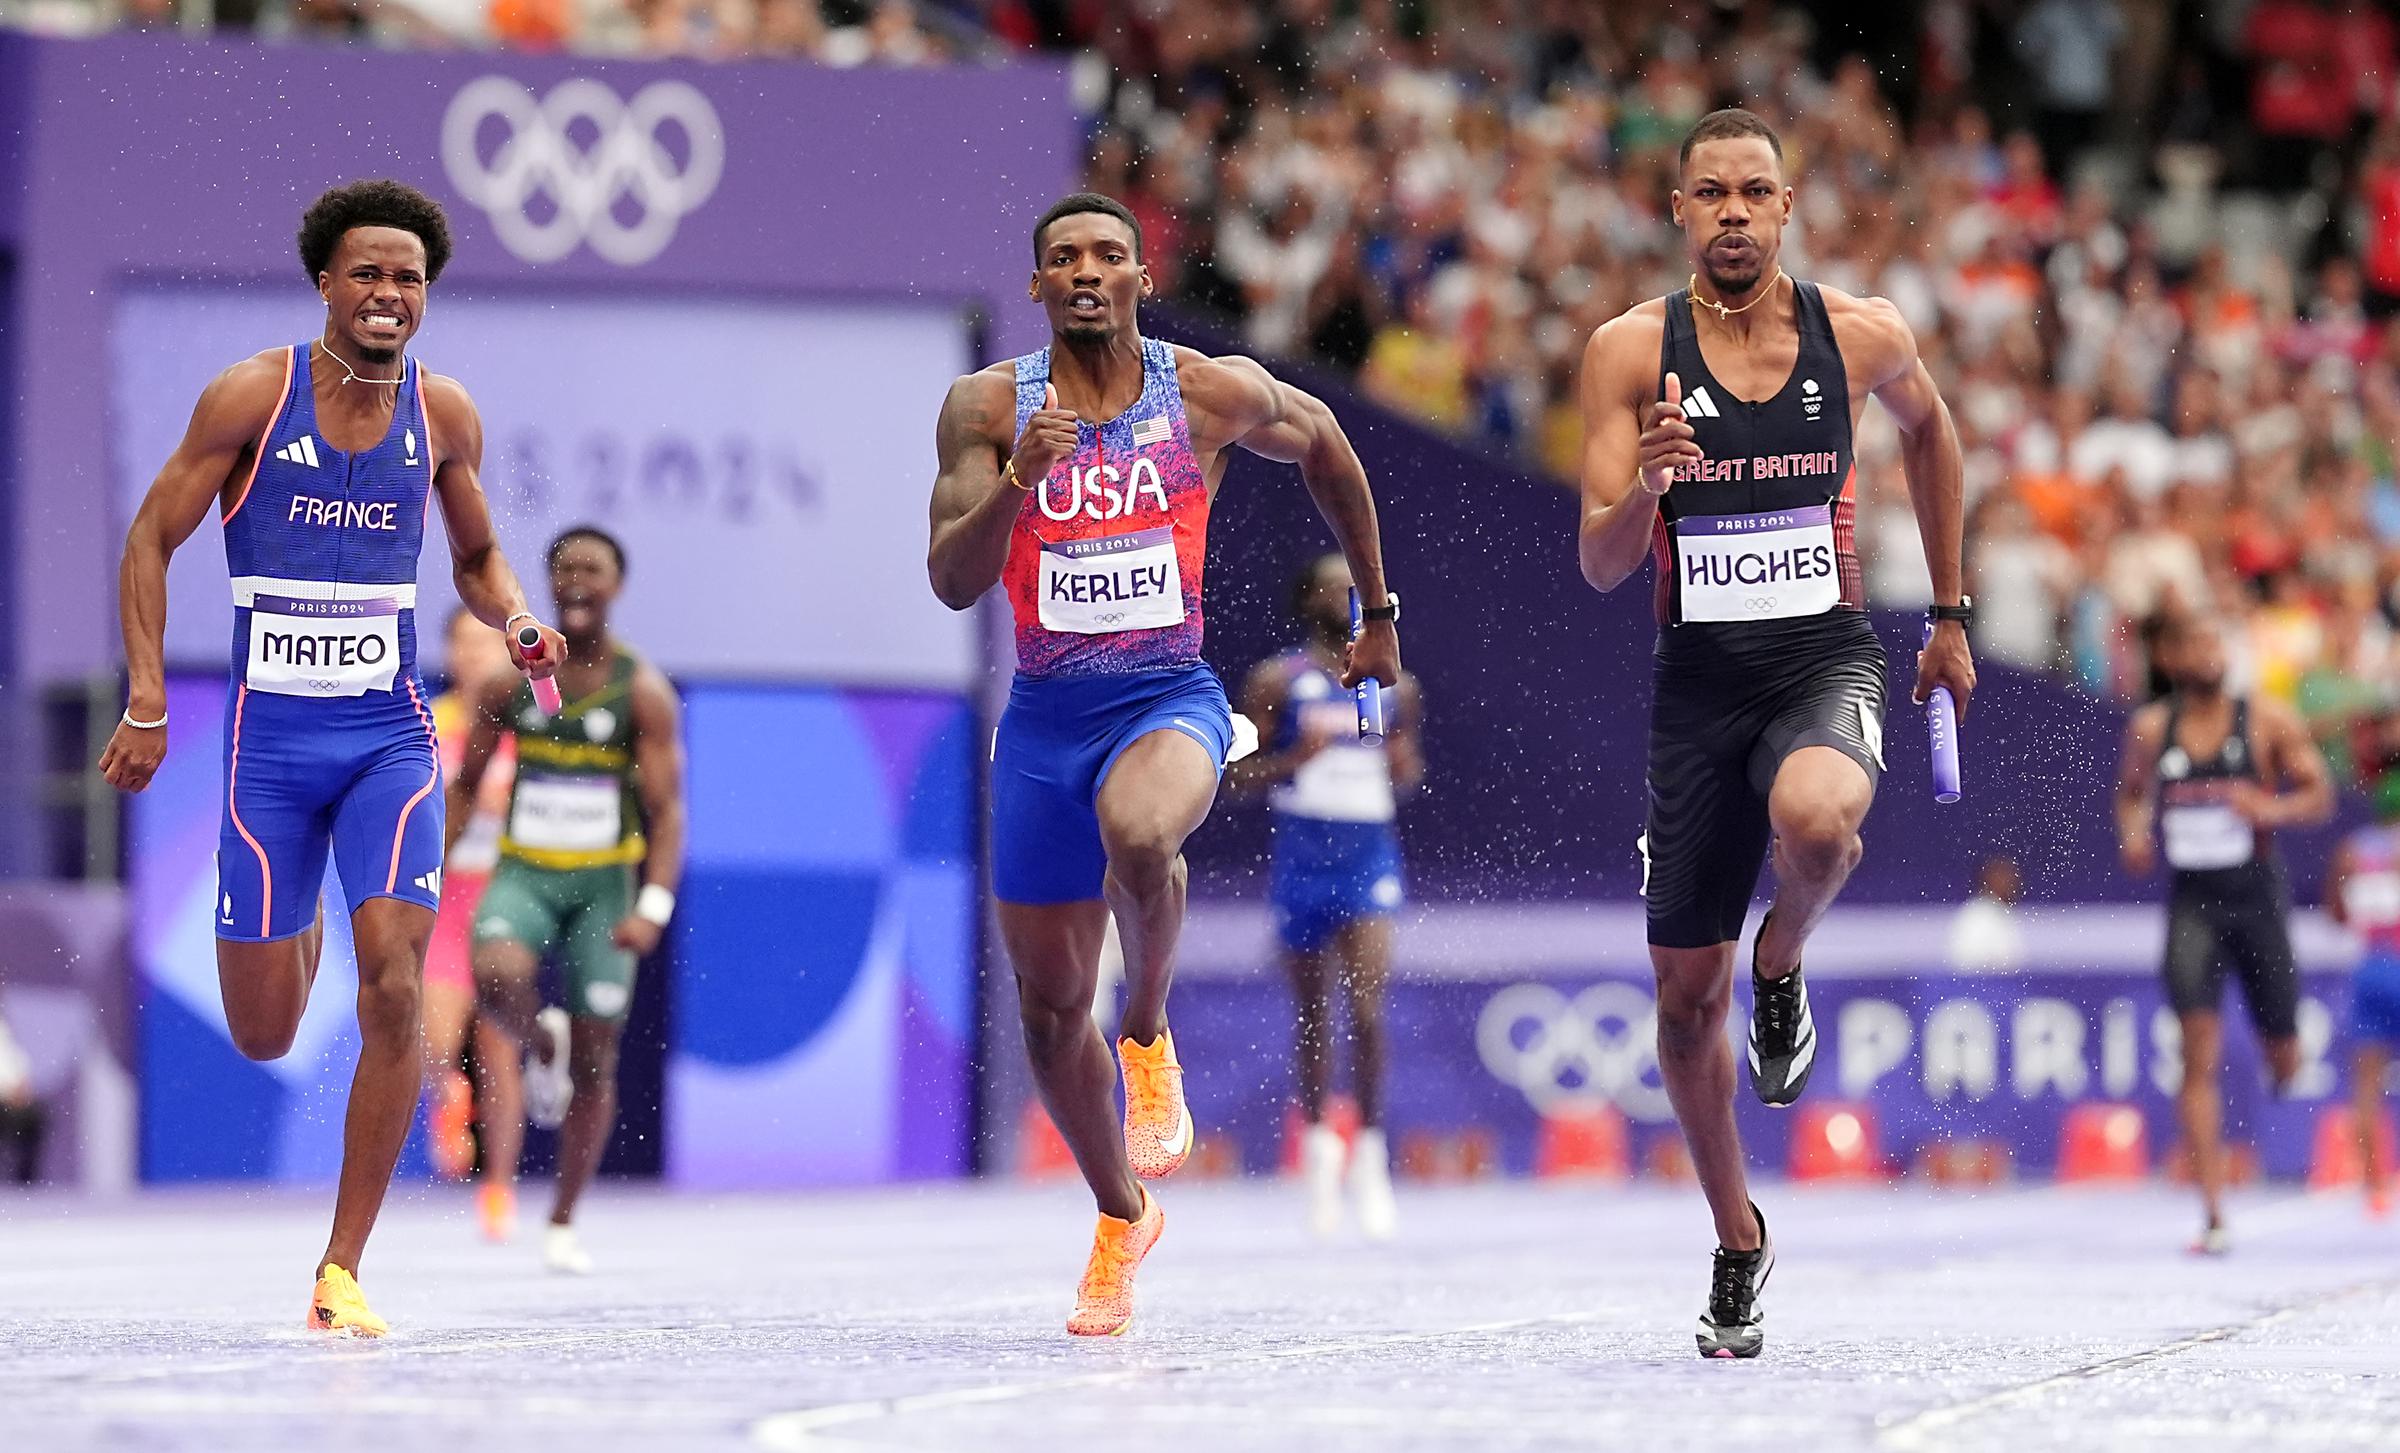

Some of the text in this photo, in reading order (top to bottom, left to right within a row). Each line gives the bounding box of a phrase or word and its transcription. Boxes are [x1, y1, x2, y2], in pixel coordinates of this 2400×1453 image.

[1673, 451, 1838, 482] GREAT BRITAIN
[1038, 458, 1169, 521] USA
[288, 495, 398, 530] FRANCE
[1717, 515, 1794, 531] PARIS 2024
[1066, 537, 1139, 555] PARIS 2024
[1686, 545, 1832, 586] HUGHES
[1050, 563, 1168, 603] KERLEY
[290, 602, 365, 614] PARIS 2024
[262, 632, 386, 666] MATEO
[1931, 708, 1945, 751] 2024
